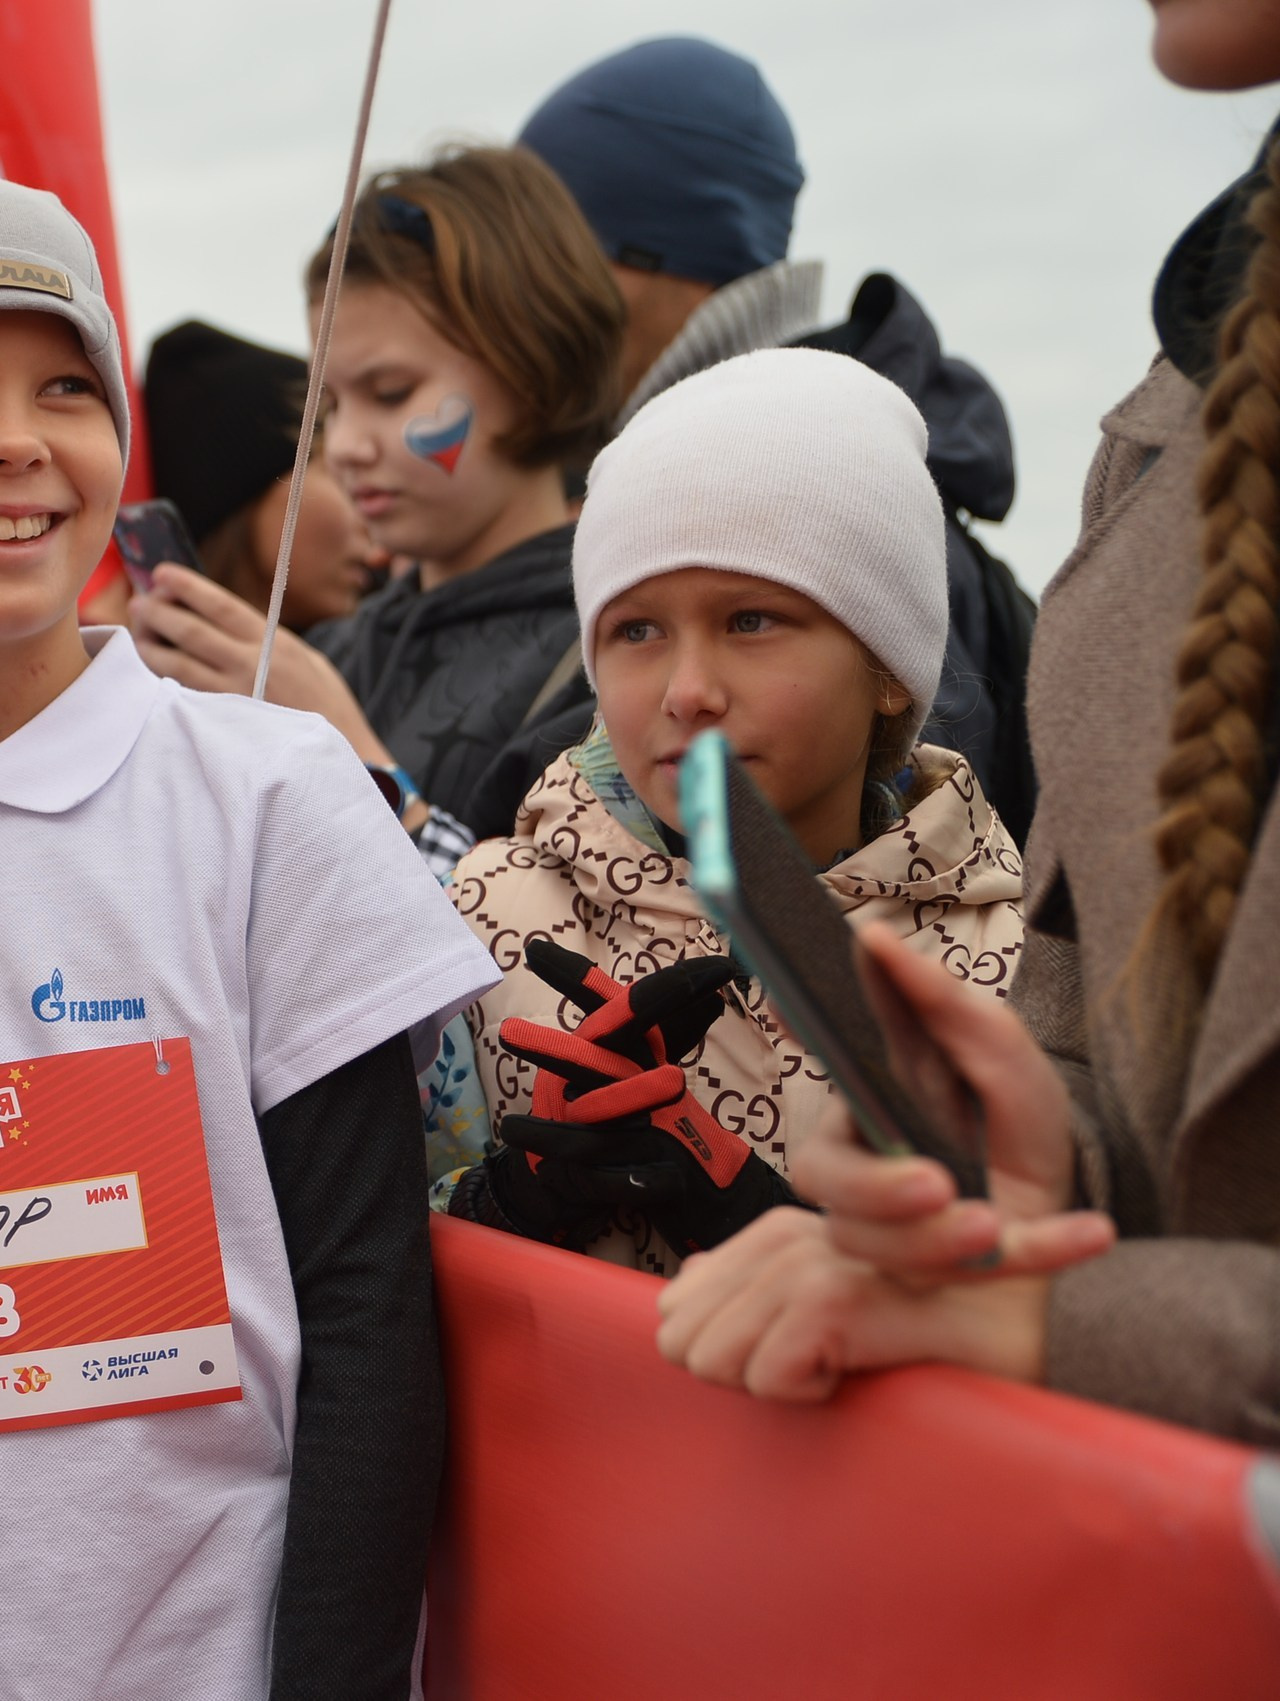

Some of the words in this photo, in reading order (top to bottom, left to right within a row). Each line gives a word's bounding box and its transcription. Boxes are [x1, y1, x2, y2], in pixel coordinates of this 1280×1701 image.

[69, 997, 146, 1022] ГАЗПРОМ
[85, 1184, 129, 1206] ИМЯ
[107, 1347, 179, 1367] ВЫСШАЯ
[107, 1365, 149, 1381] ЛИГА
